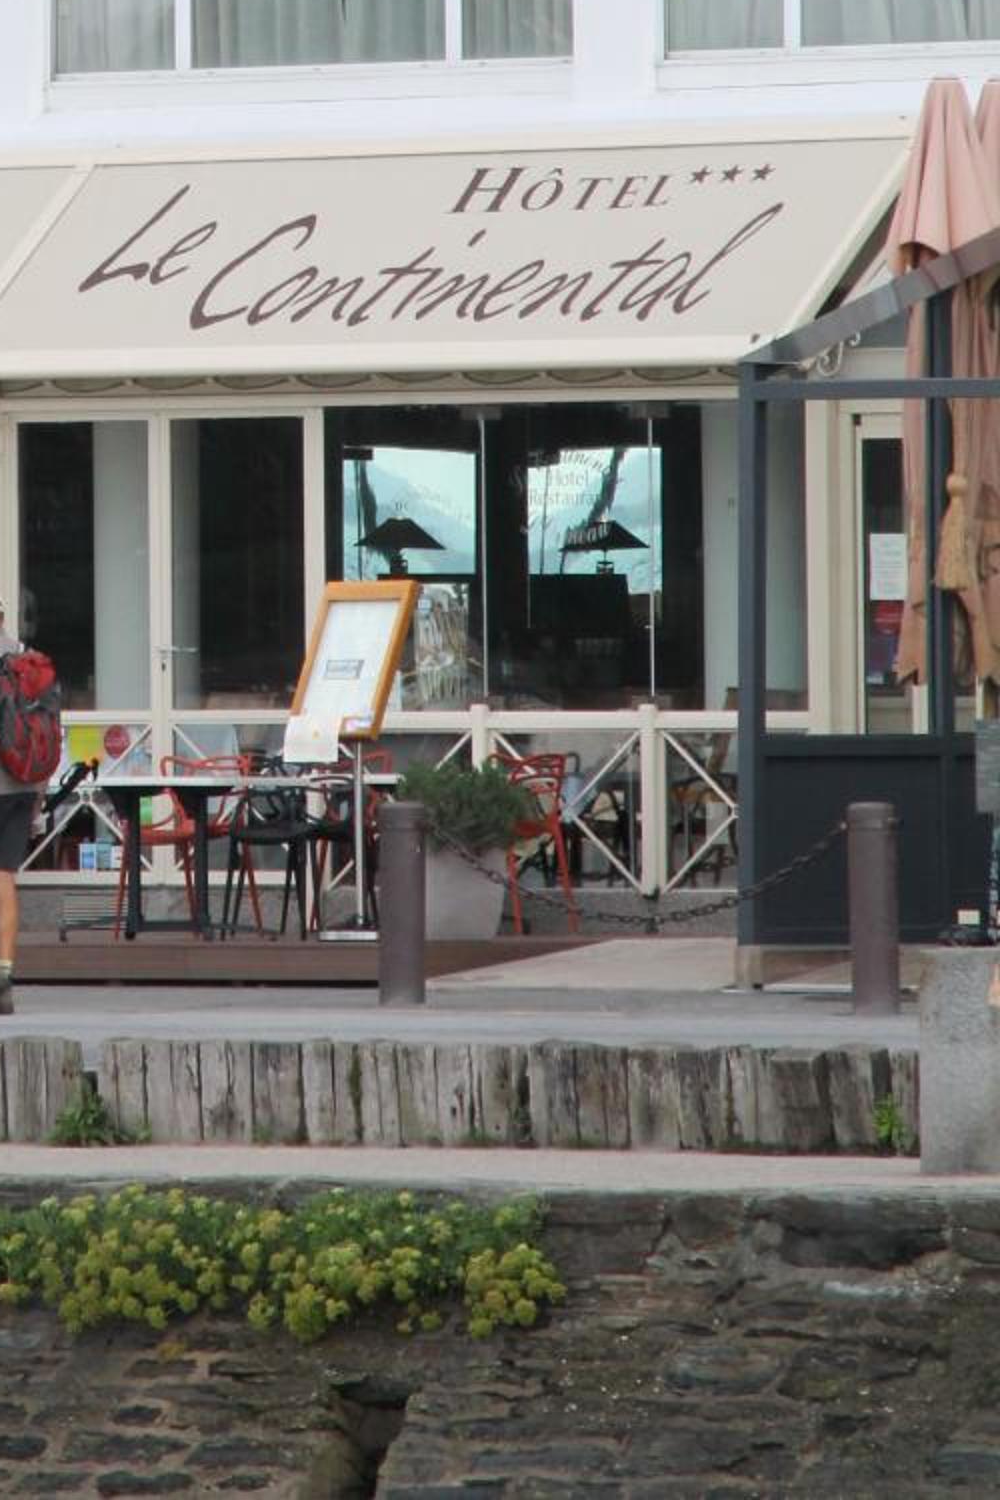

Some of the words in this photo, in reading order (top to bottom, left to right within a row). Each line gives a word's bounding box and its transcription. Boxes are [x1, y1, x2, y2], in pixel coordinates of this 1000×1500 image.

[445, 166, 675, 214] HÔTEL
[77, 183, 217, 294] Le
[188, 201, 784, 330] Continental
